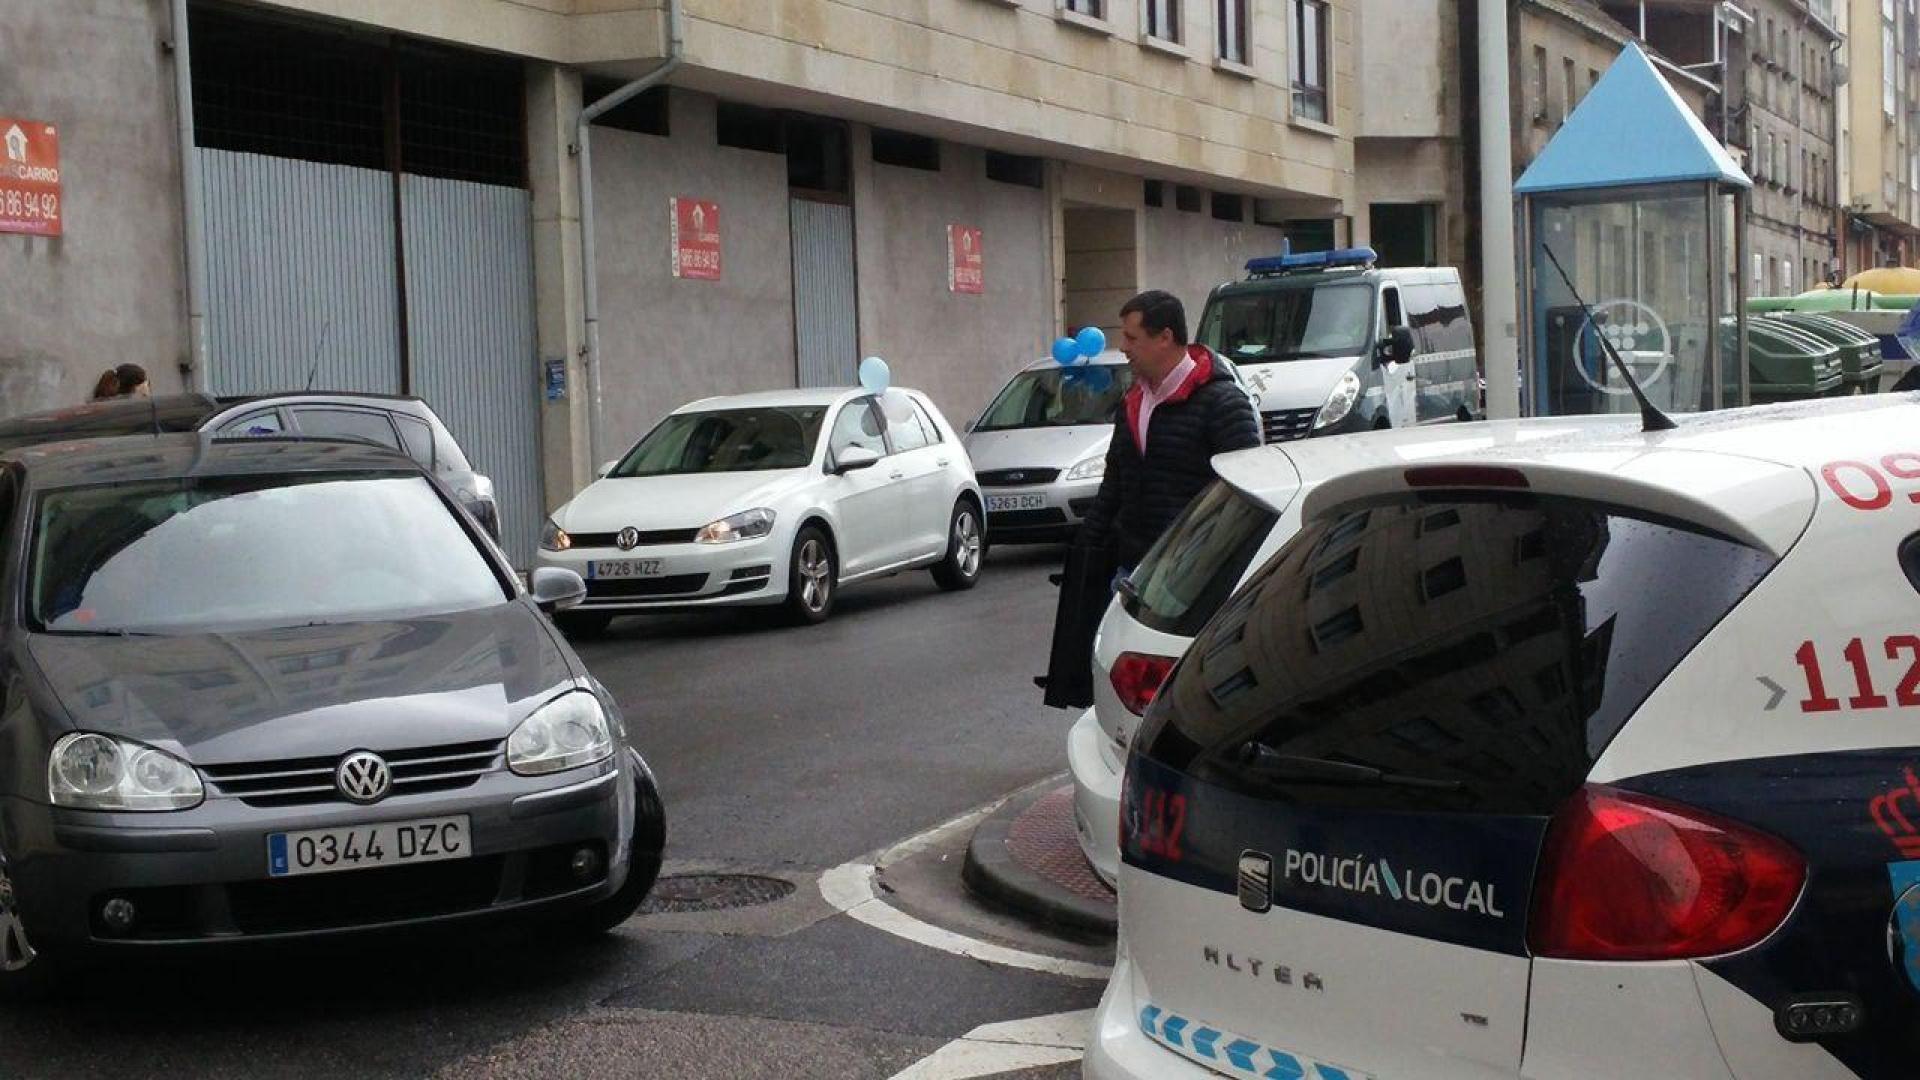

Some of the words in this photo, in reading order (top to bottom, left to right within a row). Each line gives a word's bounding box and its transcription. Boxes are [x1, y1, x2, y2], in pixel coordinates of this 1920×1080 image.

[19, 165, 59, 183] CARRO
[6, 189, 22, 217] 86
[23, 191, 40, 217] 94
[41, 193, 58, 219] 92
[990, 496, 1018, 509] 5263
[598, 562, 631, 576] 4726
[634, 560, 660, 575] HZZ
[1795, 634, 1920, 713] 112
[296, 830, 385, 868] 0344
[398, 822, 460, 858] DZC
[1285, 849, 1381, 895] POLICÍA
[1406, 869, 1504, 918] LOCAL
[1204, 946, 1324, 990] ALTEA
